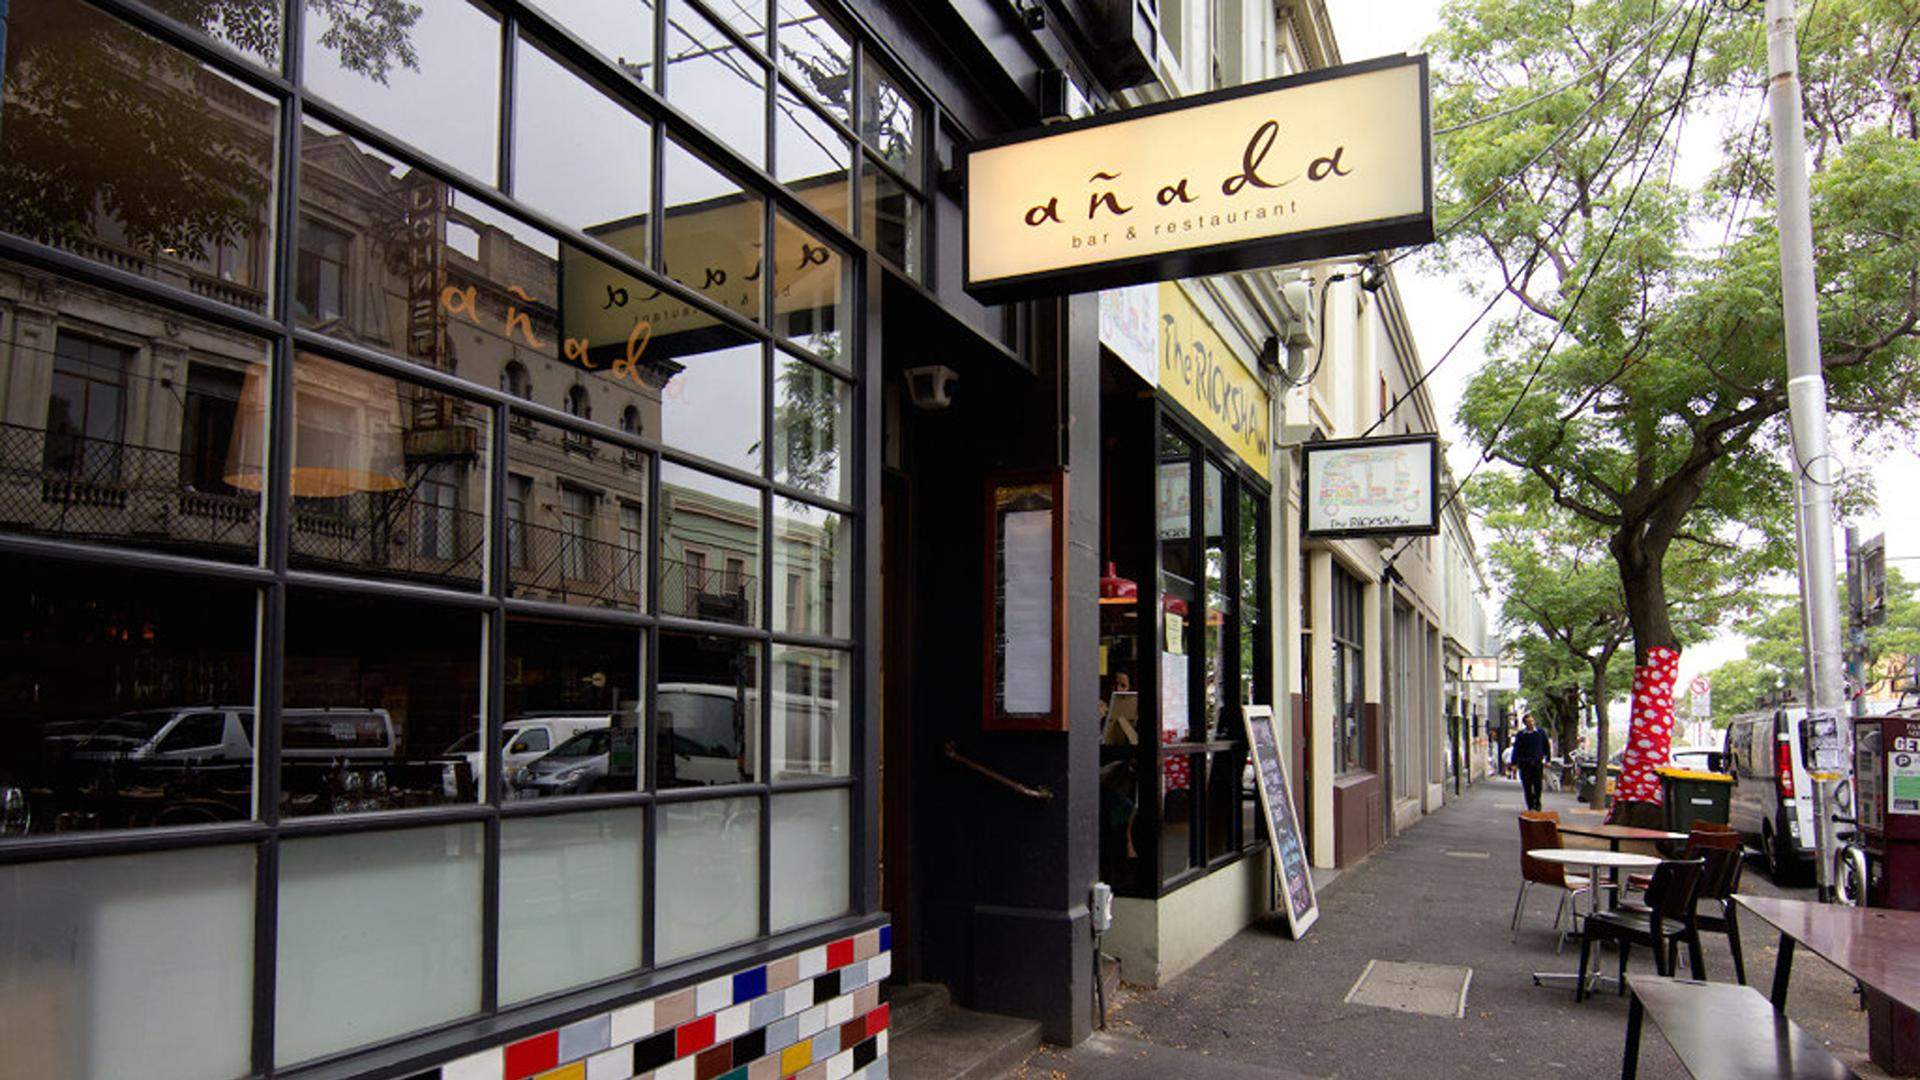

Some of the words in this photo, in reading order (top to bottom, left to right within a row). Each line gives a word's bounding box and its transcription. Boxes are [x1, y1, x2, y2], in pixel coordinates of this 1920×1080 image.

[1024, 119, 1353, 228] añada
[1071, 231, 1109, 249] bar
[1125, 225, 1137, 241] &
[1154, 200, 1298, 235] restaurant
